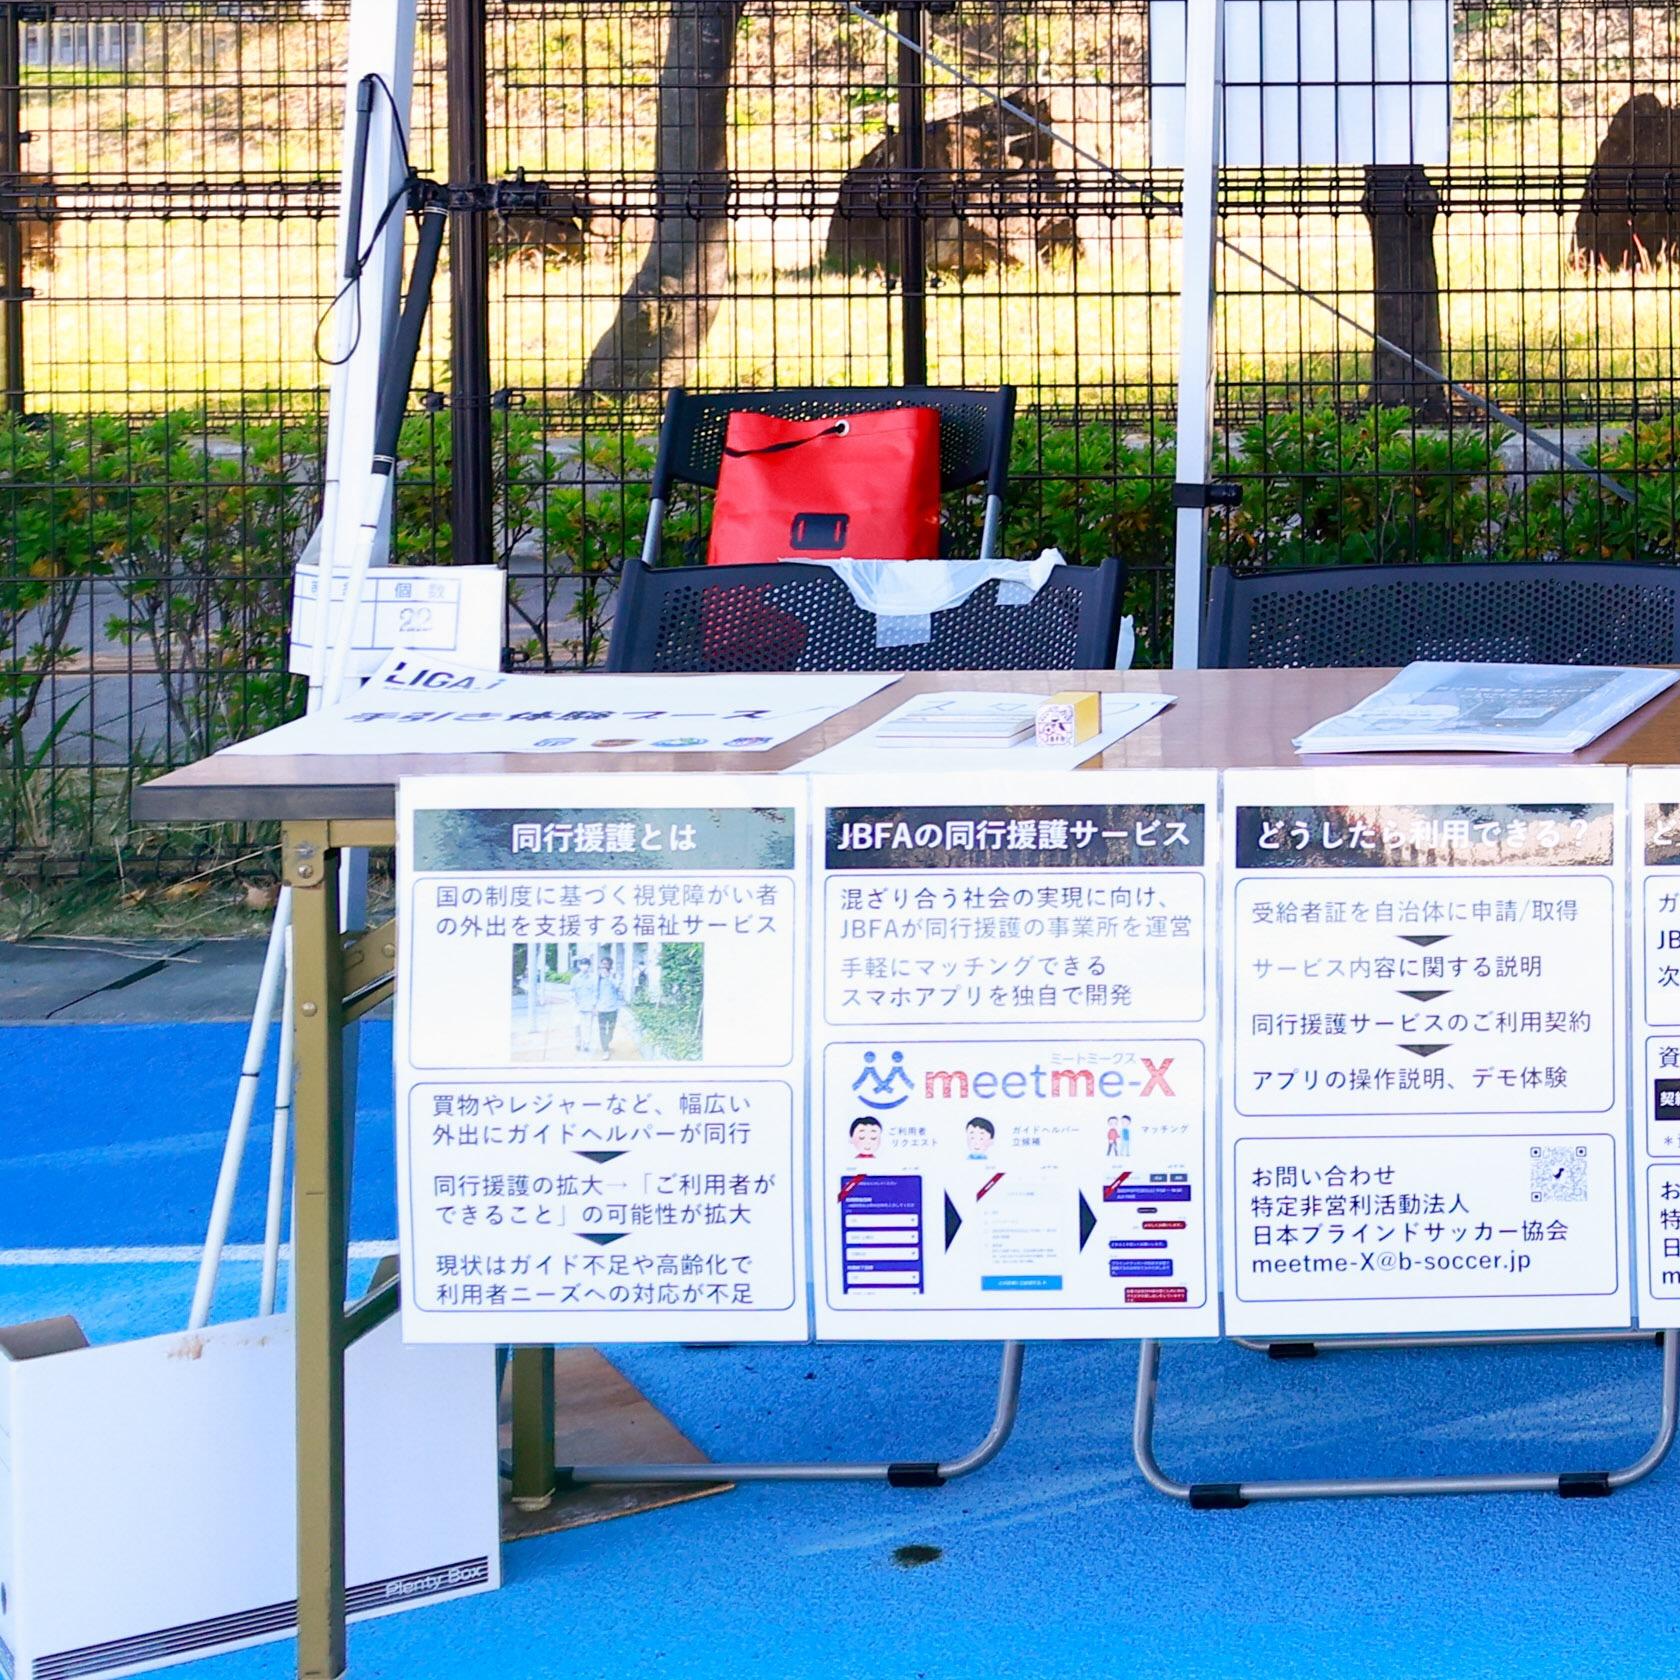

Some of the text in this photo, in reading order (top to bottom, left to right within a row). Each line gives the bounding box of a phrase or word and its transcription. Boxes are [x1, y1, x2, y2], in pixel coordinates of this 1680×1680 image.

[511, 823, 696, 853] 同行援護とは
[837, 819, 1191, 851] JBFAの同行援護サービス
[435, 884, 777, 908] 国の制度に基づく視覚障がい者
[840, 886, 1167, 911] 混ざり合う社会の実現に向け、
[1252, 899, 1579, 925] 受給者証を自治体に申請/取得
[435, 913, 776, 937] の外出を支援する福祉サービス
[840, 915, 1192, 939] JBFAが同行援護の事業所を運営
[841, 955, 1107, 979] 手軽にマッチングできる
[1252, 955, 1542, 980] サービス内容に関する説明
[842, 983, 1133, 1007] スマホアプリを独自で開発
[1252, 1010, 1592, 1036] 同行援護サービスのご利用契約
[1051, 1052, 1137, 1066] ミートミークス
[924, 1057, 1176, 1100] meetme-X
[1252, 1066, 1569, 1092] アプリの操作説明、デモ体験
[433, 1093, 751, 1117] 買物やレジャーなど、幅広い
[433, 1122, 751, 1146] 外出にガイドヘルパーが同行
[888, 1125, 927, 1137] ご利用者
[1011, 1124, 1080, 1136] ガイドヘルパー
[1141, 1123, 1190, 1136] マッチング
[892, 1137, 939, 1149] リクエスト
[1251, 1165, 1396, 1188] お問い合わせ
[435, 1203, 752, 1227] できること」の可能性が拡大
[1251, 1193, 1470, 1218] 特定非営利活動法人
[1253, 1220, 1569, 1247] 日本ブラインドサッカー協会
[436, 1254, 753, 1277] 現状はガイド不足や高齢化で
[1252, 1250, 1531, 1274] meetme-X@b-soccer.jp
[437, 1283, 754, 1305] 利用者ニーズへの対応が不足
[448, 1565, 484, 1584] Box
